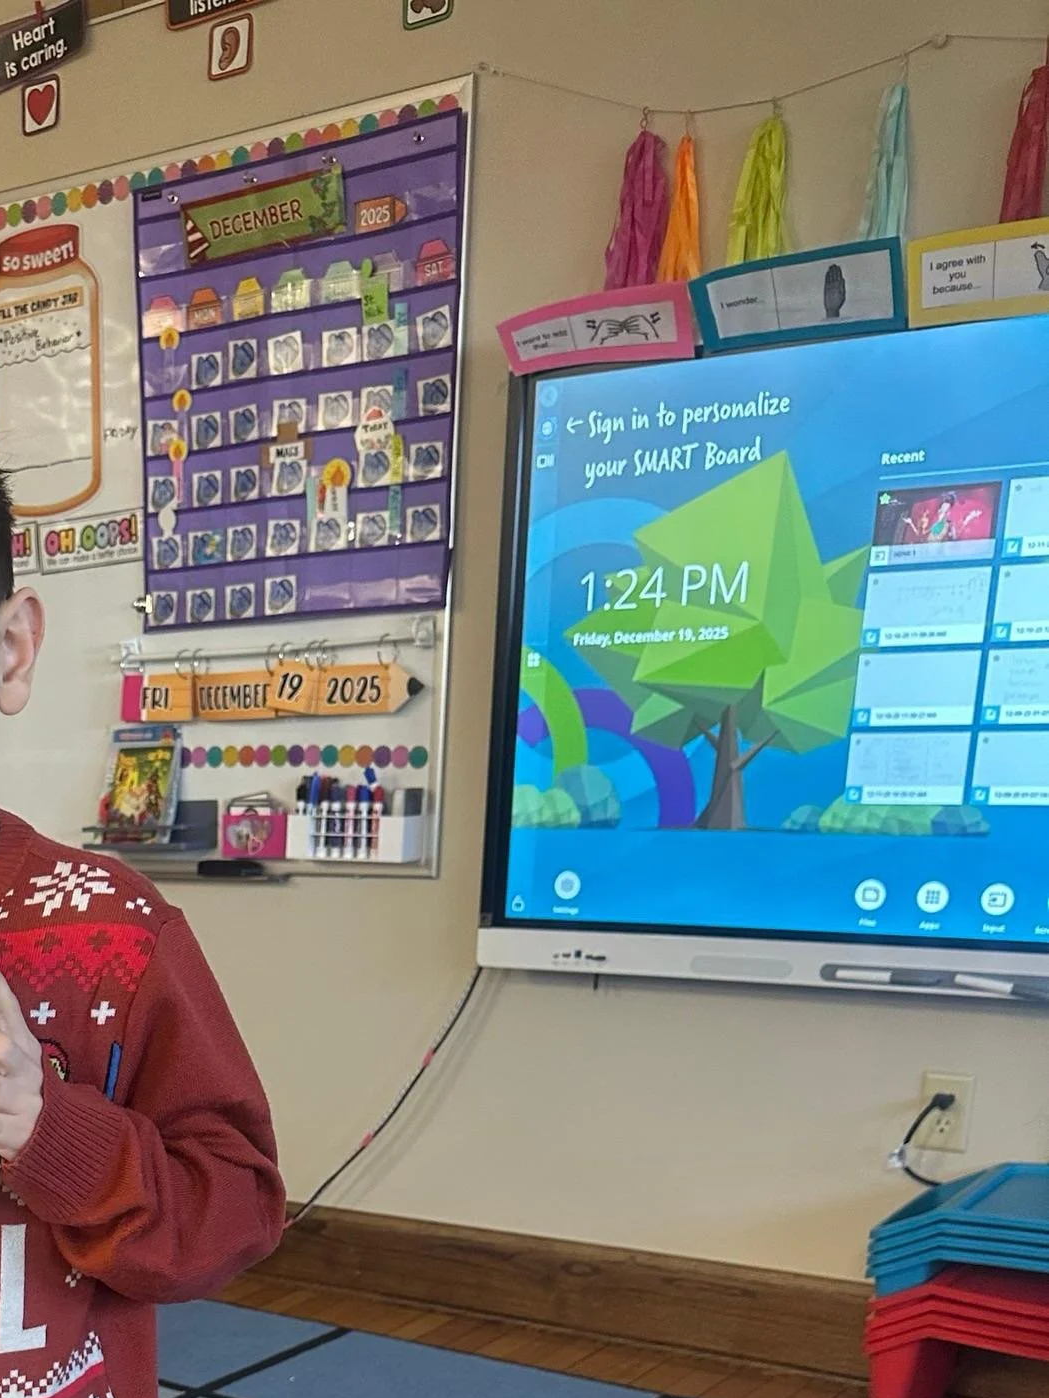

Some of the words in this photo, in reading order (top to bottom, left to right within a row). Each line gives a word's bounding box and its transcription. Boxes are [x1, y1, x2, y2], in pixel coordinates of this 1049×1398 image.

[11, 18, 56, 51] Heart
[5, 59, 18, 79] is
[20, 37, 69, 73] caring.
[209, 199, 303, 240] DECEMBER
[360, 205, 391, 226] 2025
[2, 256, 21, 271] SO
[423, 260, 445, 277] SAT
[936, 257, 964, 271] agree
[966, 254, 986, 266] with
[949, 270, 966, 281] you
[14, 303, 28, 316] THE
[31, 297, 59, 312] CANDY
[62, 292, 78, 305] JAR
[588, 411, 625, 445] Sign
[631, 407, 649, 431] in
[656, 402, 676, 427] to
[682, 392, 791, 434] personalize
[584, 457, 628, 489] your
[634, 442, 700, 477] SMART
[704, 436, 762, 470] Board
[881, 450, 926, 466] Recent
[45, 528, 76, 557] OH
[80, 513, 138, 552] OOPS!
[580, 565, 667, 612] 1:24
[681, 560, 750, 607] PM
[573, 632, 612, 649] Friday,
[614, 628, 675, 646] December
[678, 627, 696, 643] 19,
[698, 625, 730, 641] 2025
[276, 672, 303, 701] 19
[327, 675, 382, 705] 2025
